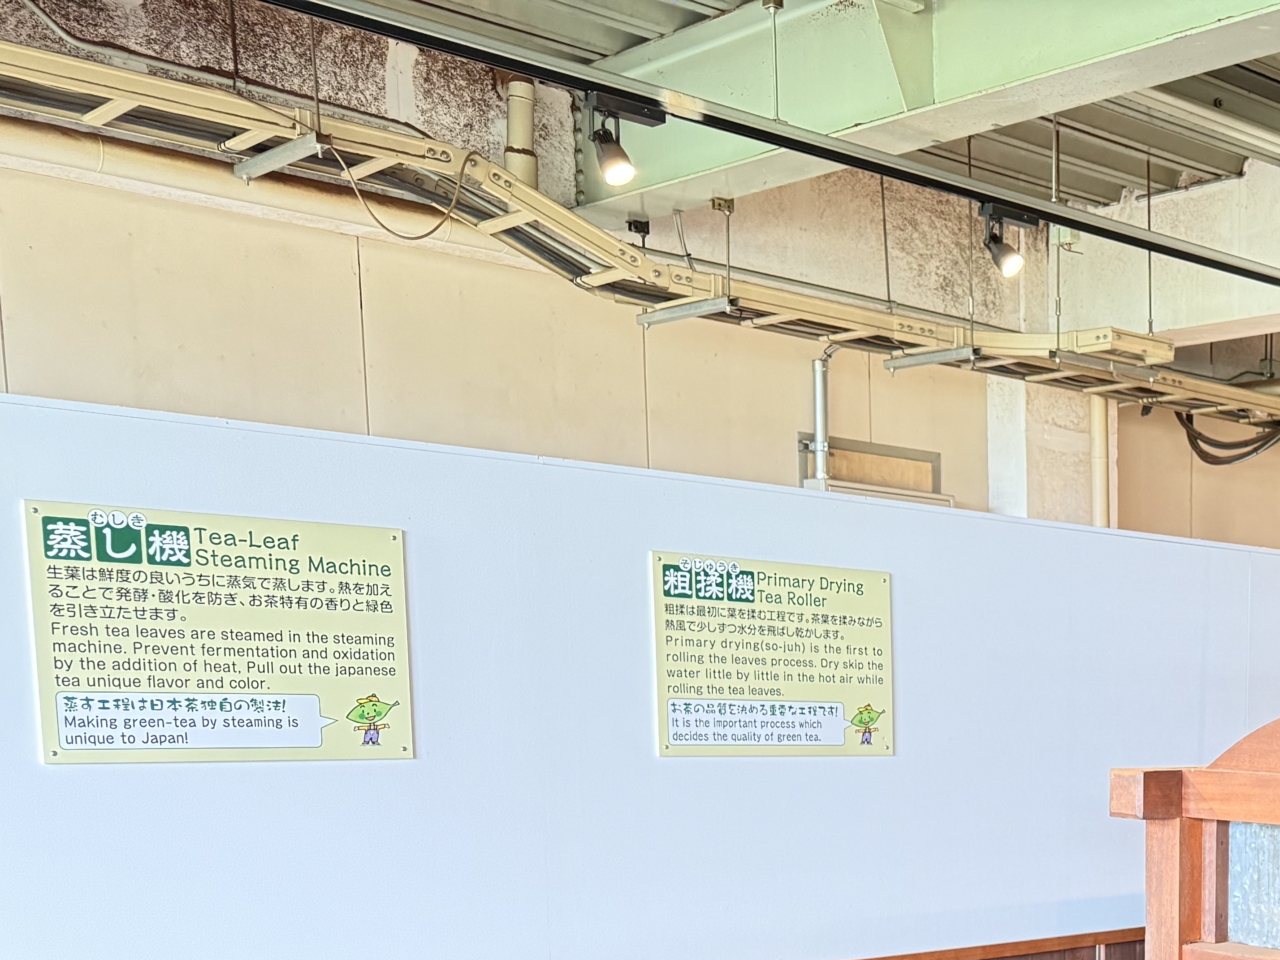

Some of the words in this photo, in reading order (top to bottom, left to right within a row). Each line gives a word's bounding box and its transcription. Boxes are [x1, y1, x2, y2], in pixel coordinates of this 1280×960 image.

[90, 511, 144, 528] むしき
[46, 521, 190, 564] 蒸し機
[193, 527, 300, 551] Tea-Leaf
[195, 548, 301, 575] Steaming
[308, 555, 392, 577] Machine
[680, 558, 739, 574] そじゅうき
[46, 565, 393, 597] 生葉は鮮度の良いうちに蒸気で蒸します。熱を加え
[663, 568, 755, 601] 粗揉機
[756, 571, 815, 592] Primary
[819, 576, 864, 596] Drying
[757, 589, 782, 605] Tea
[787, 591, 827, 608] Roller
[49, 603, 187, 622] を引き立たせます。
[51, 622, 99, 637] Fresh
[105, 624, 130, 637] tea
[136, 624, 186, 639] leaves
[190, 629, 216, 640] are
[220, 629, 283, 643] steamed
[288, 630, 301, 643] in
[306, 631, 329, 644] the
[333, 633, 395, 648] steaming
[52, 640, 127, 654] machine.
[133, 641, 196, 656] Prevent
[201, 643, 297, 659] fermentation
[302, 647, 328, 659] and
[333, 649, 396, 661] oxidation
[665, 635, 716, 650] Primary
[720, 638, 806, 654] drying(so-juh)
[810, 643, 820, 653] is
[824, 643, 842, 655] the
[846, 644, 868, 656] first
[872, 647, 883, 656] to
[53, 656, 73, 671] by
[79, 657, 106, 671] the
[111, 658, 177, 672] addition
[183, 660, 198, 672] of
[203, 659, 242, 675] heat,
[247, 661, 274, 674] Pull
[279, 662, 303, 675] out
[307, 663, 331, 675] the
[335, 663, 397, 677] japanese
[666, 651, 705, 665] rolling
[709, 653, 727, 664] the
[731, 654, 767, 666] leaves
[771, 658, 817, 668] process.
[820, 658, 840, 670] Dry
[843, 660, 864, 671] skip
[867, 660, 884, 671] the
[55, 674, 80, 687] tea
[86, 674, 142, 689] unique
[146, 675, 190, 689] flavor
[196, 676, 224, 689] and
[229, 677, 271, 690] color.
[666, 668, 701, 679] water
[705, 668, 732, 680] little
[736, 669, 750, 682] by
[754, 670, 780, 681] little
[783, 671, 793, 682] in
[797, 672, 815, 683] the
[818, 672, 836, 684] hot
[839, 674, 853, 684] air
[857, 674, 884, 685] while
[667, 683, 703, 696] rolling
[706, 684, 725, 695] the
[728, 685, 745, 696] tea
[748, 685, 784, 697] leaves.
[64, 715, 118, 729] Making
[123, 716, 197, 730] green-tea
[201, 716, 217, 730] by
[222, 716, 283, 729] steaming
[287, 716, 299, 728] is
[671, 717, 679, 728] It
[682, 717, 691, 728] is
[695, 718, 710, 728] the
[713, 718, 758, 730] important
[760, 720, 796, 730] process
[798, 719, 823, 729] which
[65, 732, 115, 746] unique
[120, 732, 136, 744] to
[142, 732, 189, 746] Japan!
[672, 731, 709, 742] decides
[712, 731, 728, 742] the
[731, 731, 762, 743] quality
[764, 731, 774, 742] of
[777, 732, 802, 743] green
[805, 733, 822, 742] tea.
